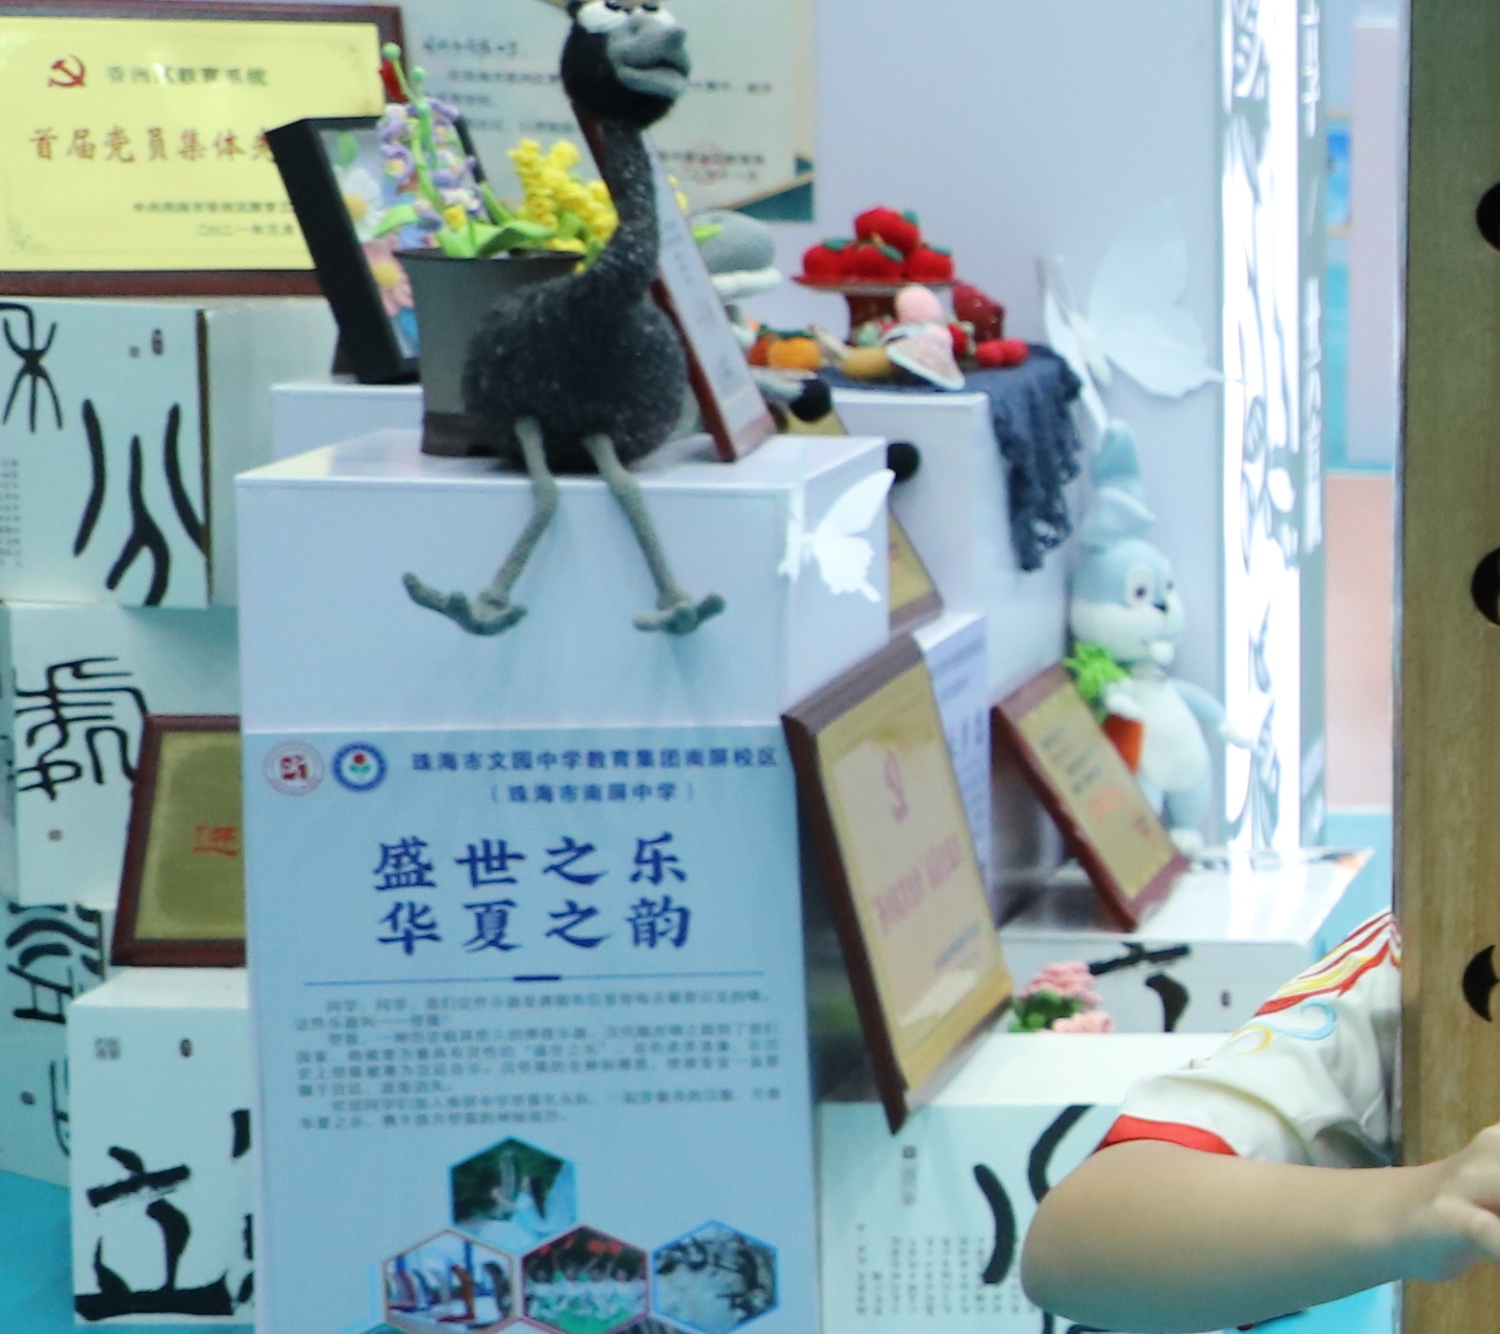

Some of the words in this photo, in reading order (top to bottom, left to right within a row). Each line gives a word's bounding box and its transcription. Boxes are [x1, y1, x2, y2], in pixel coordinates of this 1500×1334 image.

[411, 745, 781, 773] 珠海市文园中学教育集团南屏校区
[373, 831, 688, 892] 盛世之乐
[377, 894, 692, 957] 华夏之韵
